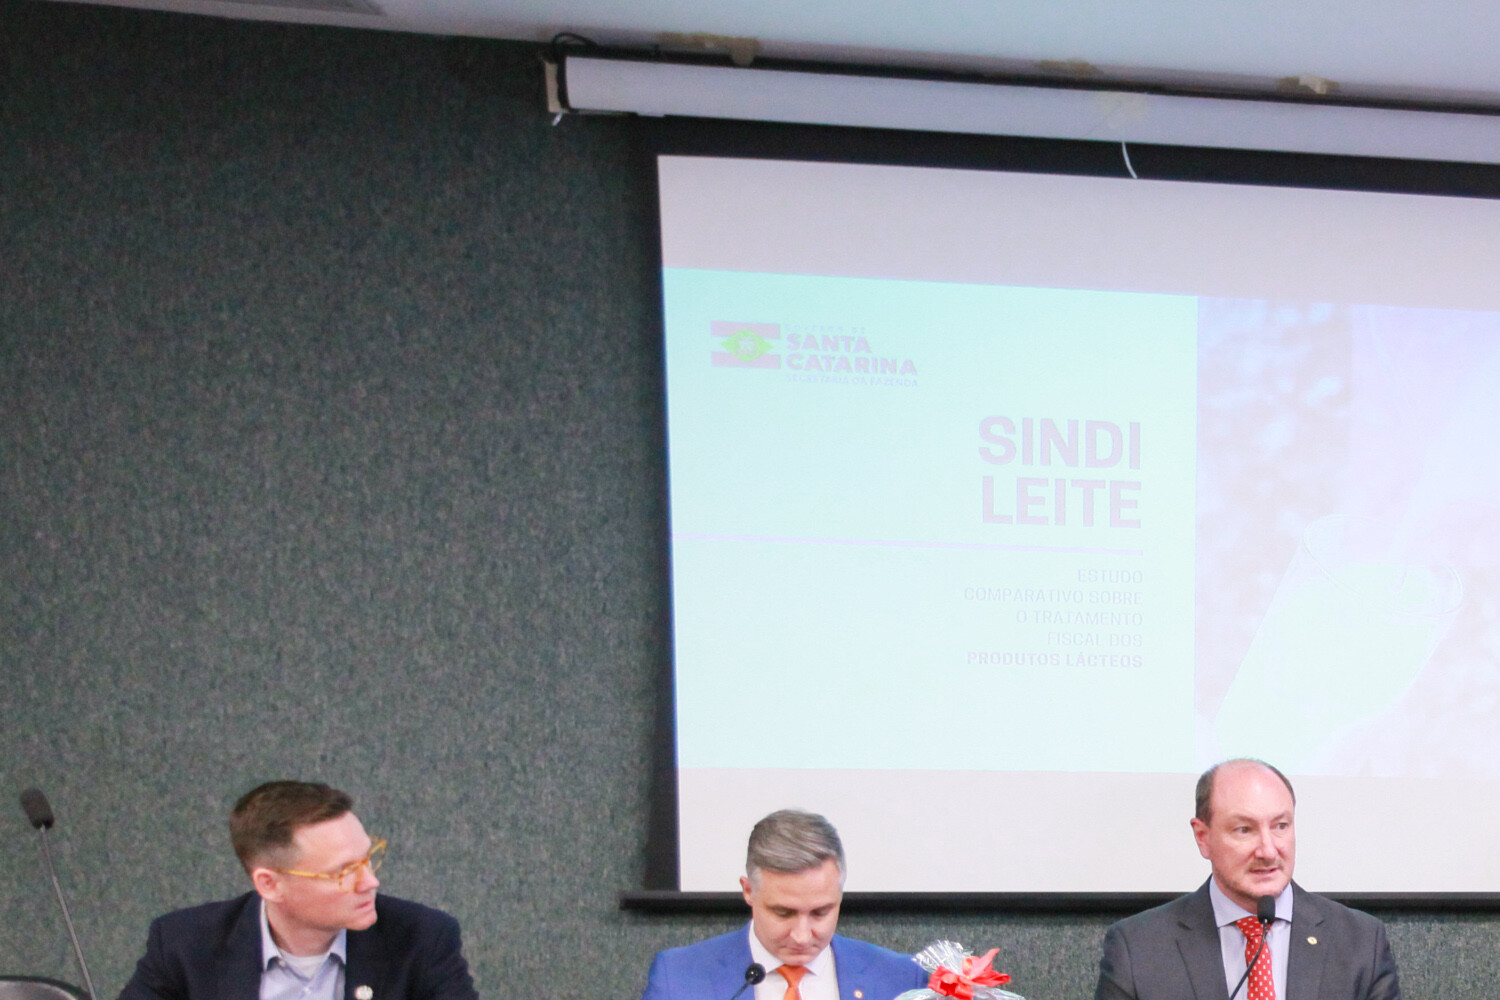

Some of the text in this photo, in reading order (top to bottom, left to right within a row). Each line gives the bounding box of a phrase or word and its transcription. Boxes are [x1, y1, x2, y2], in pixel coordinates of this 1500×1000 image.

[786, 333, 872, 353] SANTA
[786, 353, 918, 375] CATARINA
[870, 376, 919, 387] FAZENDA
[978, 415, 1141, 470] SINDI
[982, 476, 1142, 529] LEITE
[1077, 568, 1143, 584] ESTUDO
[963, 587, 1143, 606] COMPARATIVO SOBRE
[1016, 610, 1143, 626] O TRATAMENTO
[1047, 631, 1143, 647] FISCAL DOS
[967, 651, 1143, 668] PRODUTOS LÁCTEOS
